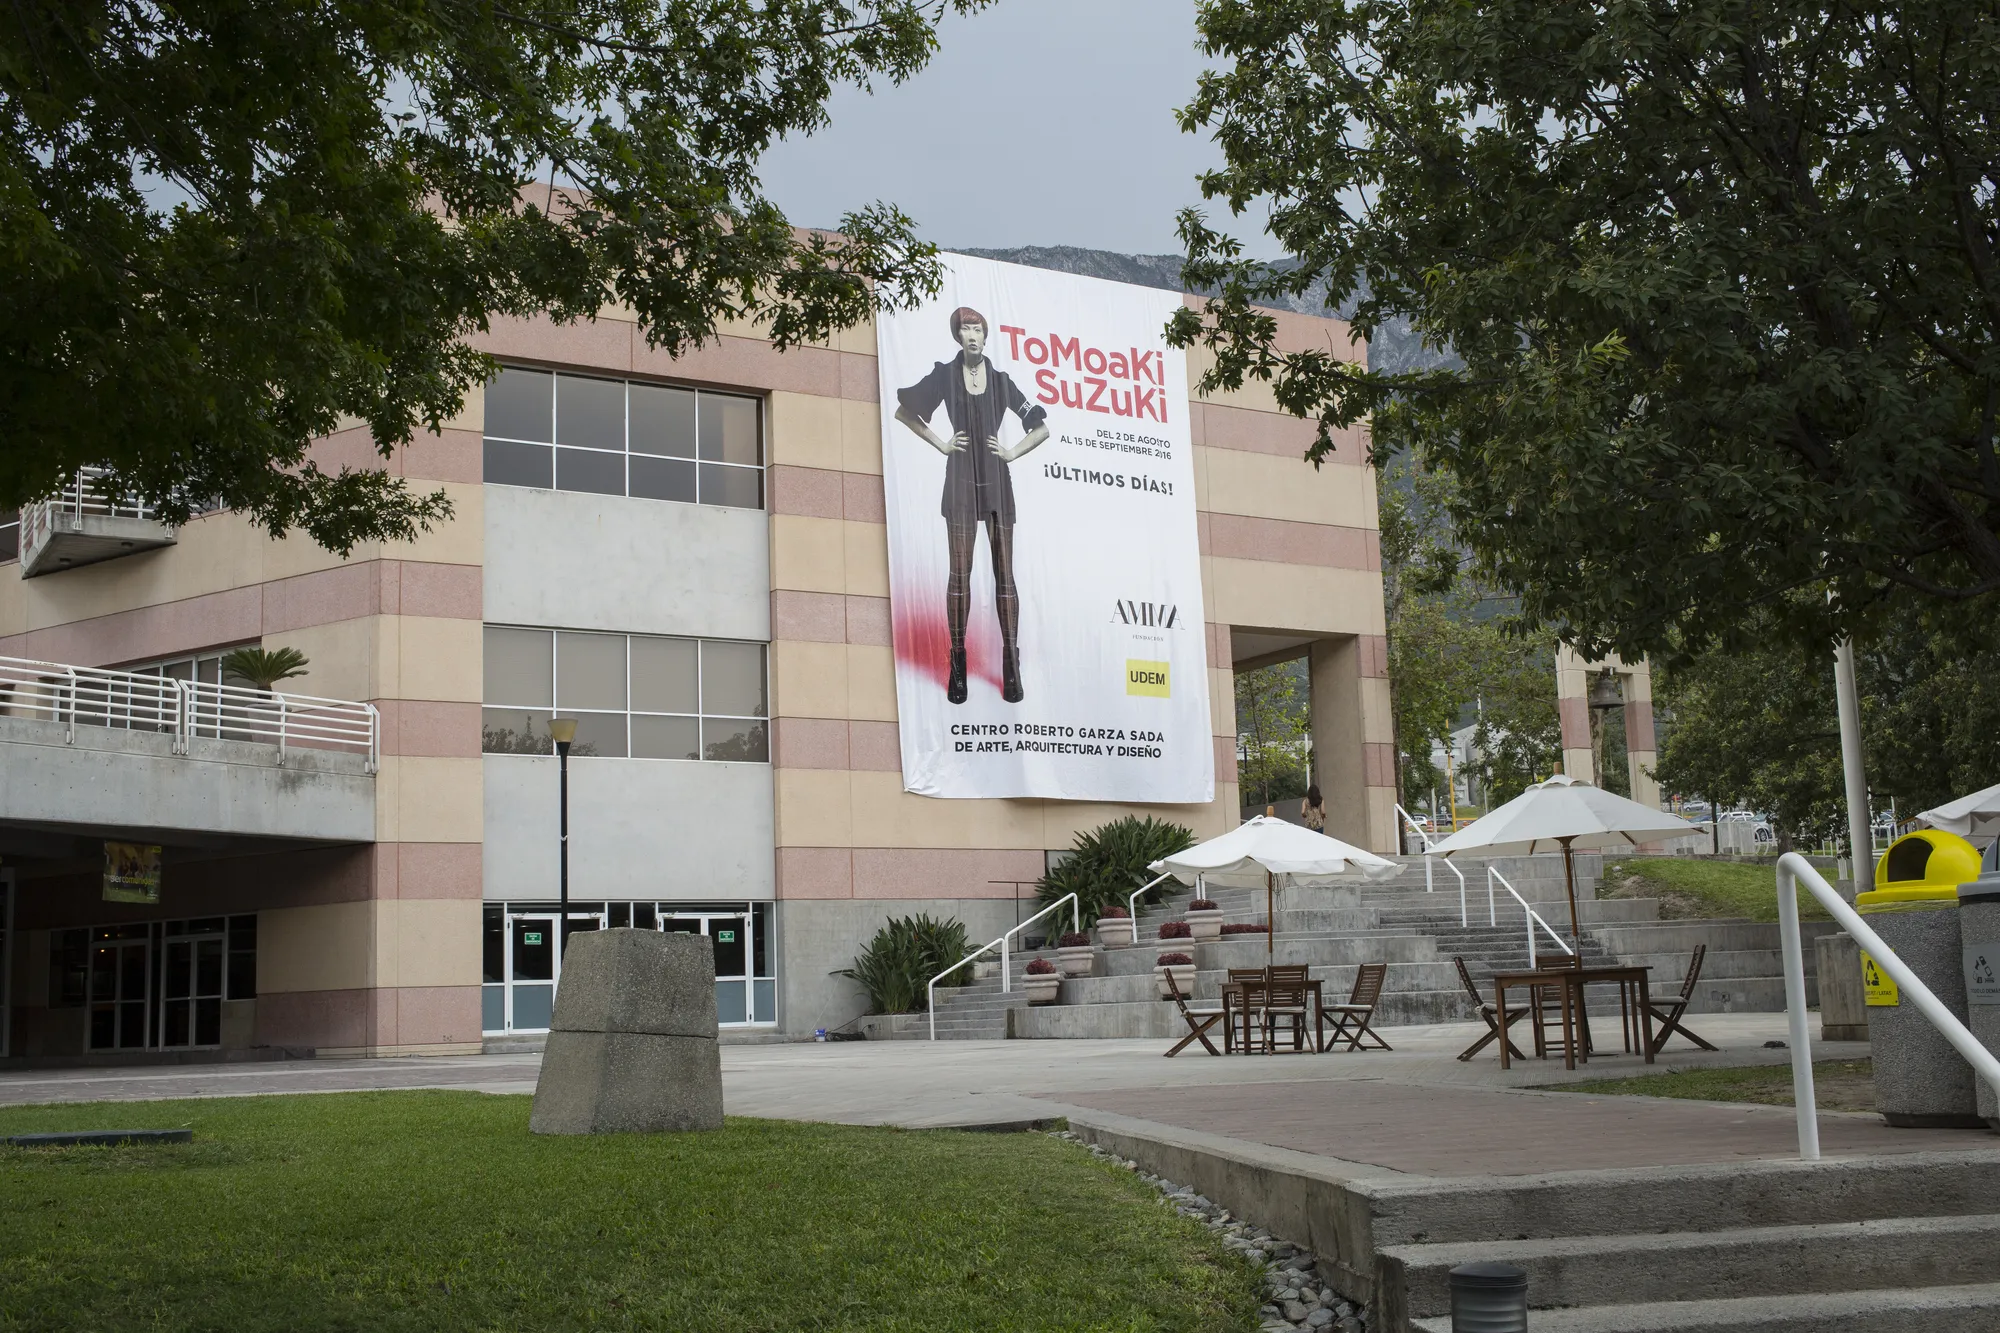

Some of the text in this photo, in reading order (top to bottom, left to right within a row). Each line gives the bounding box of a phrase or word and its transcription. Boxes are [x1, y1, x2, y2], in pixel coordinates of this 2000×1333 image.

[999, 324, 1165, 387] ToMoaKi
[1034, 368, 1168, 424] SuZuKi
[1060, 435, 1073, 445] AL
[1074, 436, 1083, 446] 15
[1085, 438, 1097, 448] DE
[1099, 440, 1153, 457] SEPTIEMBRE
[1096, 429, 1114, 441] DEL
[1116, 432, 1122, 441] 2
[1123, 433, 1136, 443] DE
[1044, 462, 1174, 496] ¡ÚLTIMOS DÍAS!
[1109, 598, 1185, 631] AMMA
[1130, 670, 1165, 686] UDEM
[950, 723, 1165, 743] CENTRO ROBERTO GARZA SADA
[954, 740, 1162, 759] DE ARTE, ARQUITECTURA Y DISEÑO
